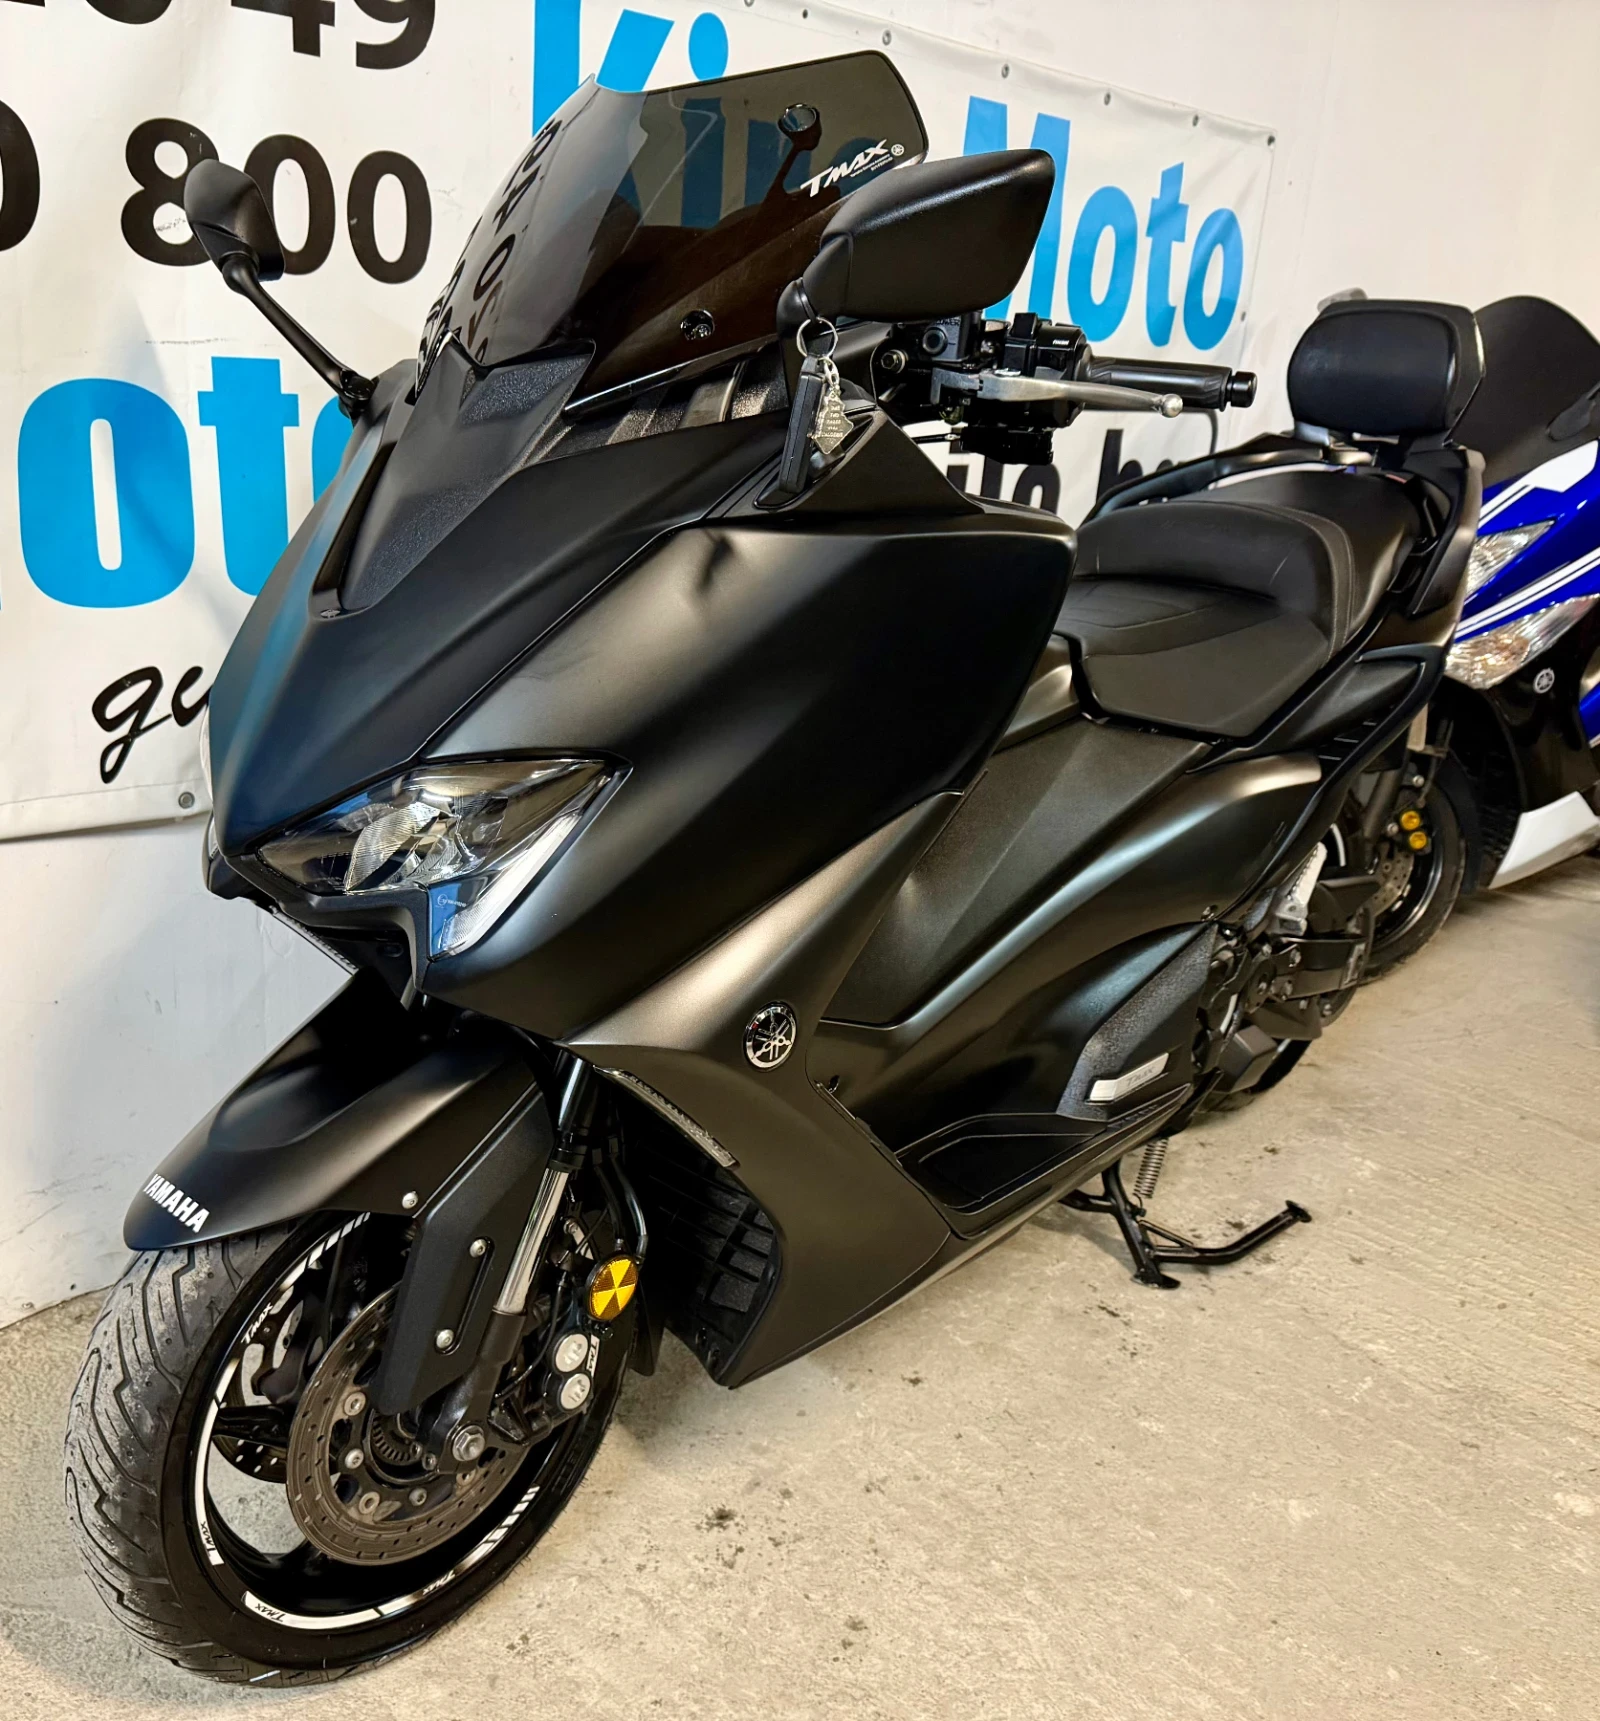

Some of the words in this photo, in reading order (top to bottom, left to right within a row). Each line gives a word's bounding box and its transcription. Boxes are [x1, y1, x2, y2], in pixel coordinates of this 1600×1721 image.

[800, 139, 888, 197] TMAX
[121, 118, 432, 284] 800
[143, 1173, 210, 1233] YAMAHA
[240, 1301, 274, 1344] TMAX
[255, 1602, 286, 1623] TMAX
